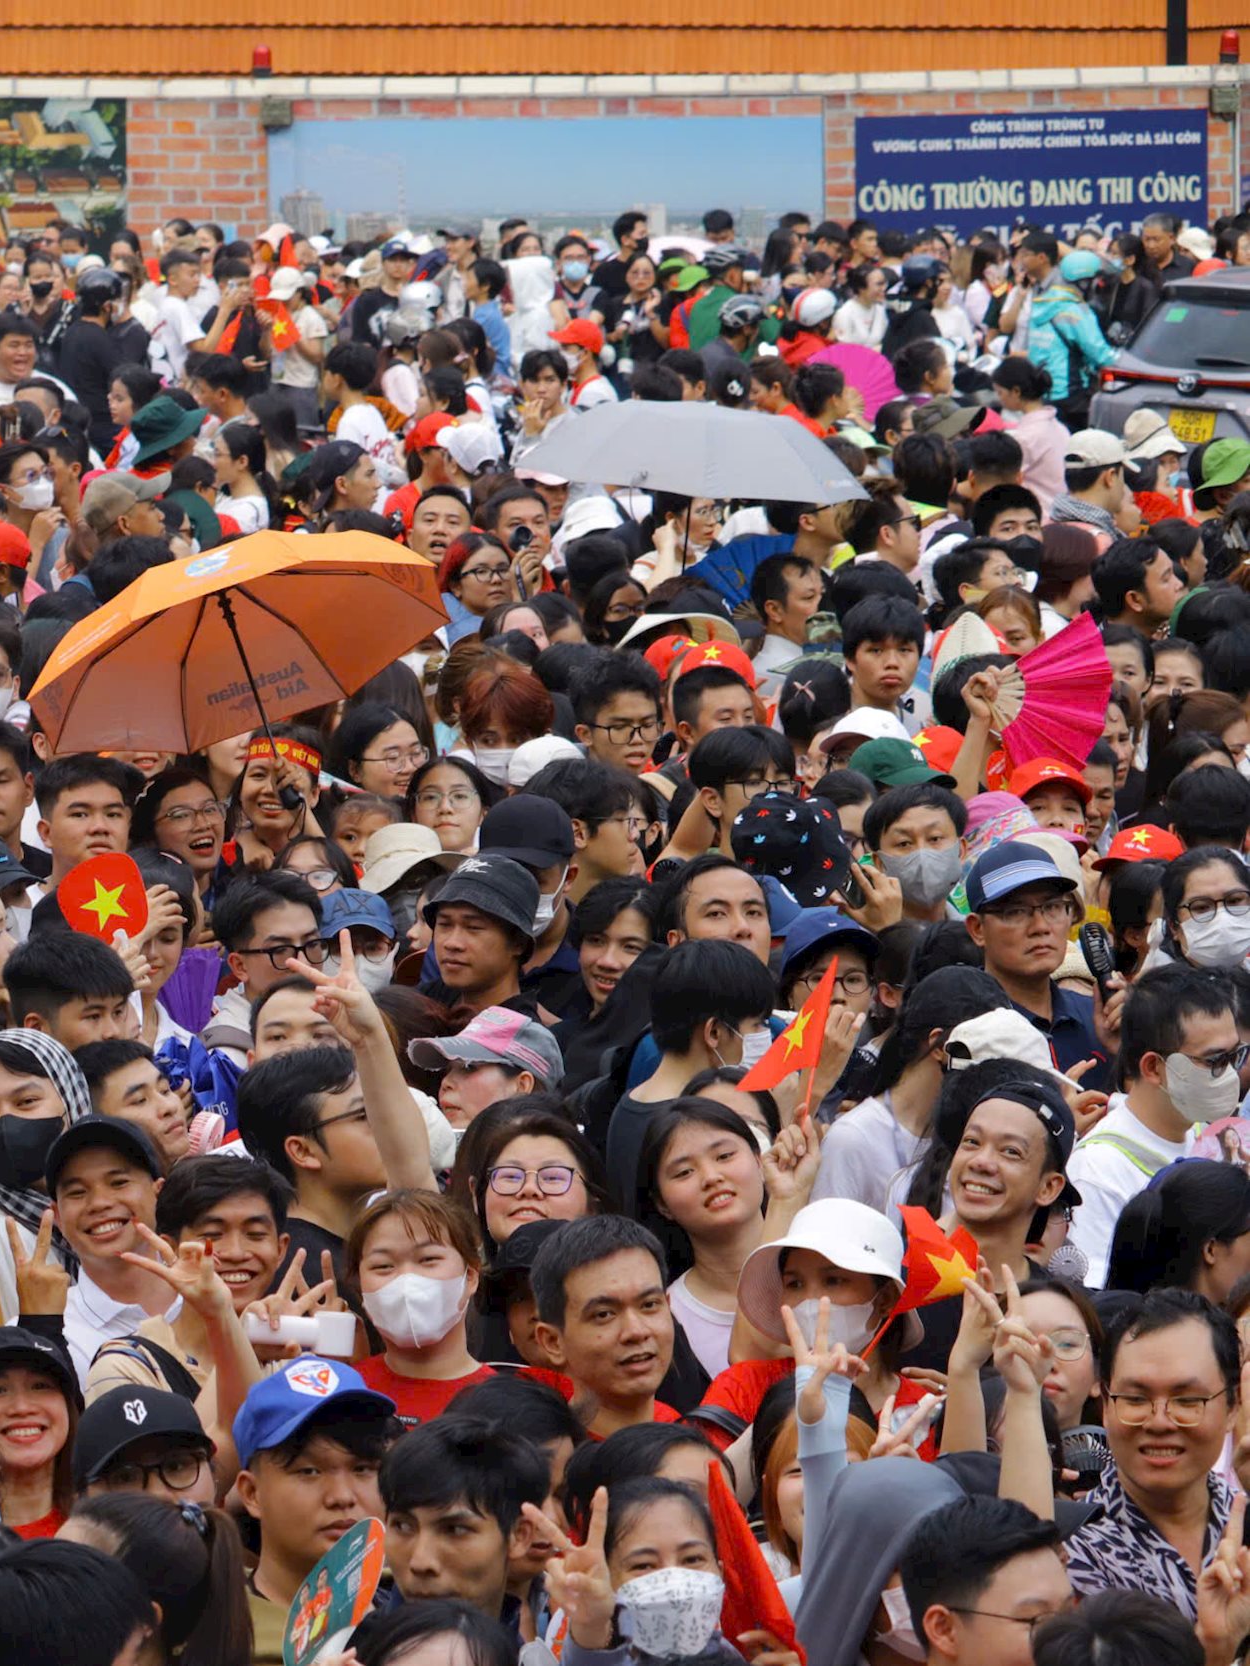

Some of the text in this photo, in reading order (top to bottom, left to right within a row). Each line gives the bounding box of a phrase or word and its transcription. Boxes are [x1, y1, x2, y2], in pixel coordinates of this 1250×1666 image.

[970, 119, 1004, 133] CÔNG
[1088, 118, 1105, 130] TU
[919, 139, 952, 152] CUNG
[1135, 131, 1152, 146] BÀ
[1154, 130, 1174, 145] SÀI
[1175, 130, 1201, 144] GÒN
[859, 171, 1202, 213] CÔNG TRƯỜNG ĐANG THI CÔNG
